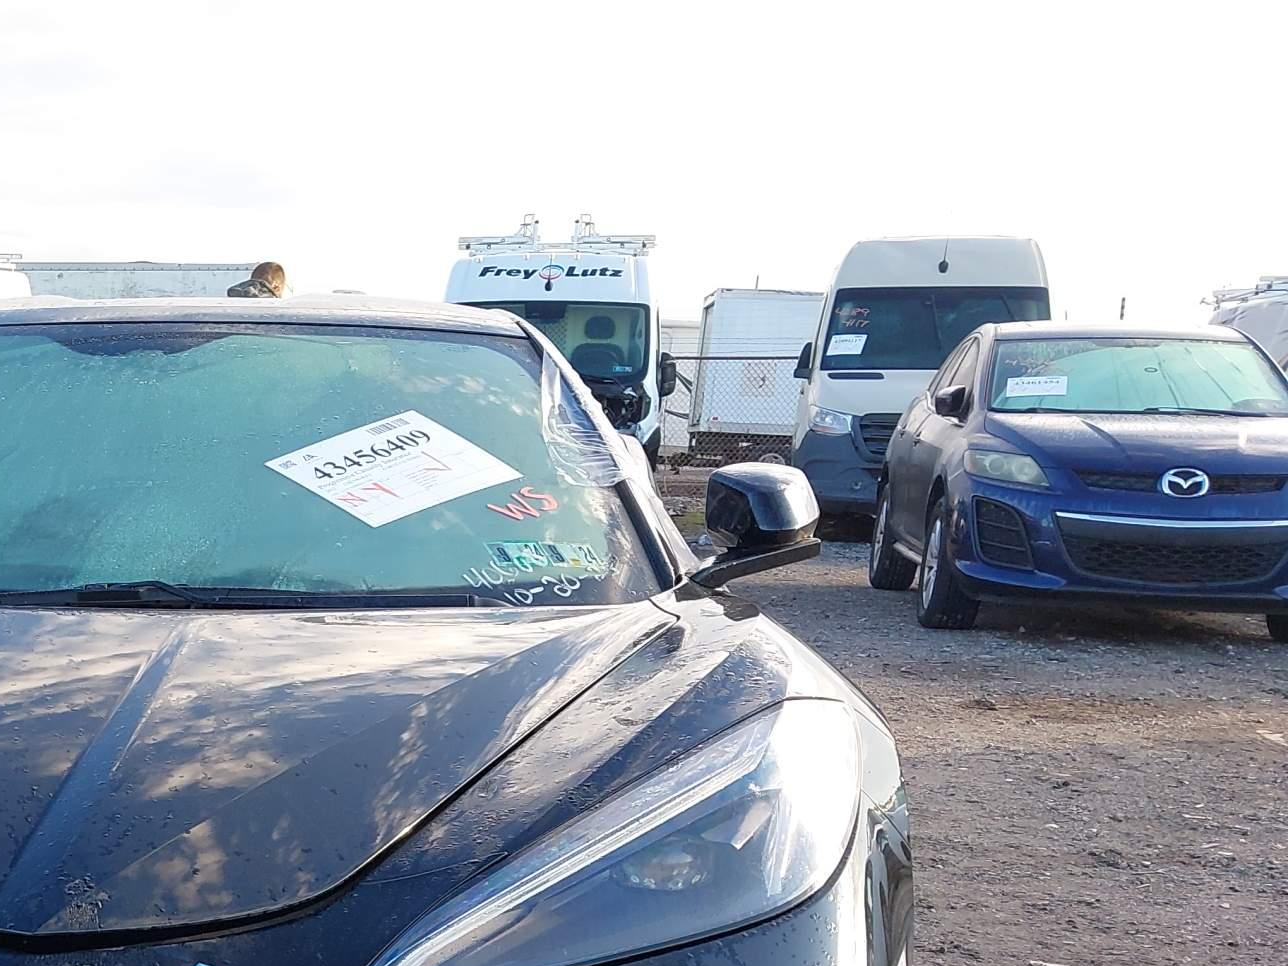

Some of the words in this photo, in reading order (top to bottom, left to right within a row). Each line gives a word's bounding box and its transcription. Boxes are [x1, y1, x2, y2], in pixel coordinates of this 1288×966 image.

[478, 265, 539, 279] Frey
[564, 265, 624, 278] Lutz
[313, 429, 431, 481] 43456409
[486, 486, 559, 520] WS
